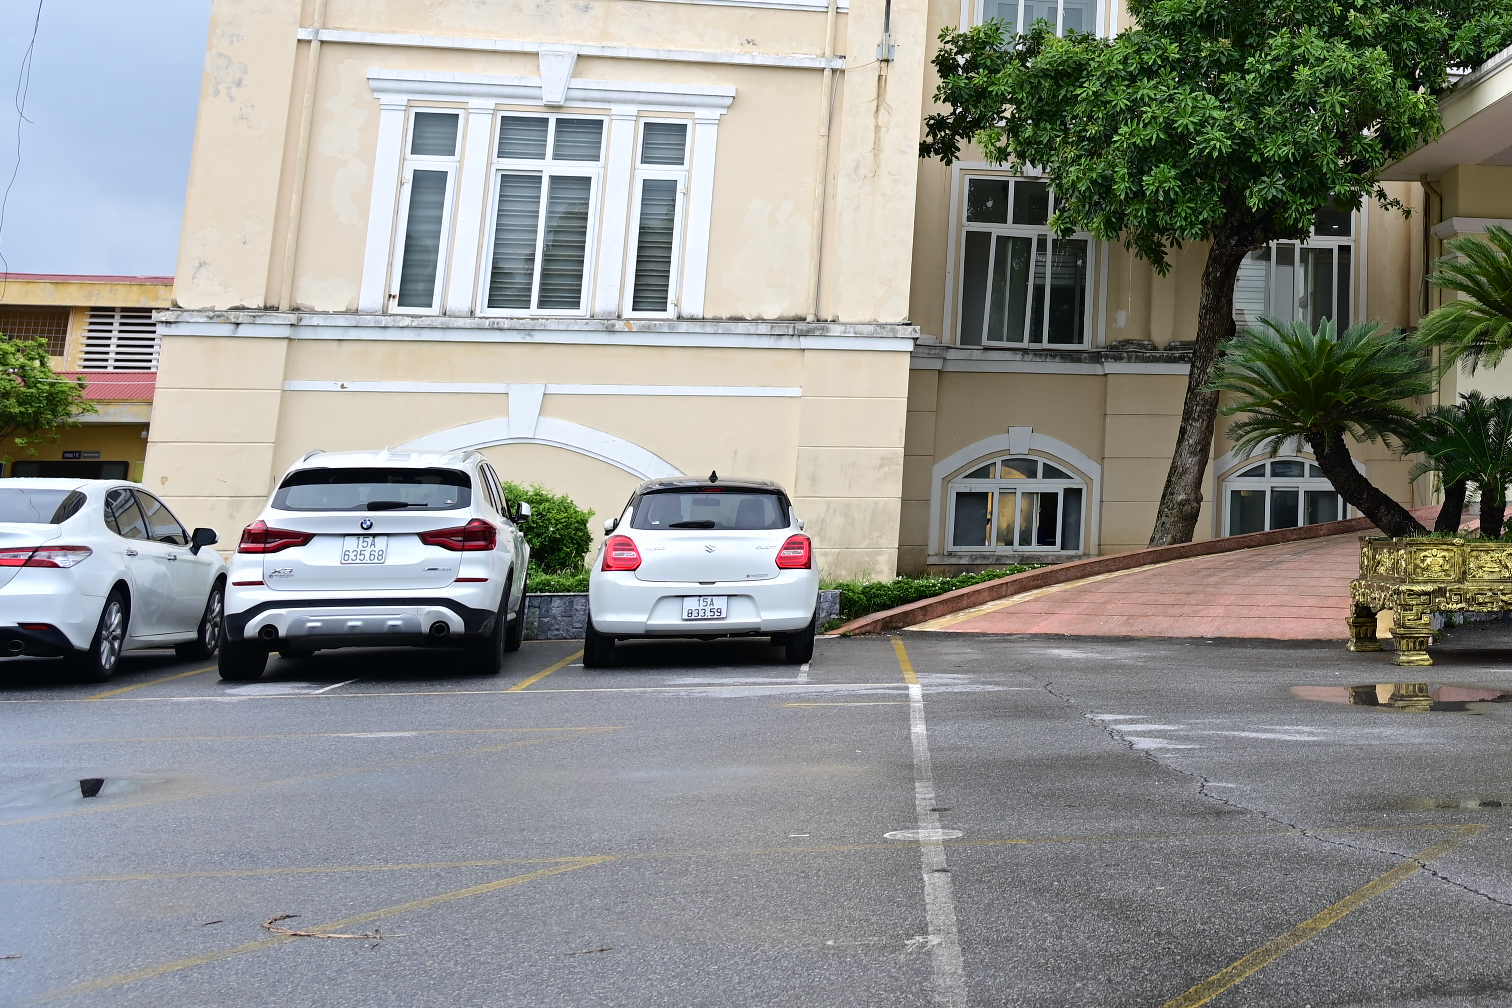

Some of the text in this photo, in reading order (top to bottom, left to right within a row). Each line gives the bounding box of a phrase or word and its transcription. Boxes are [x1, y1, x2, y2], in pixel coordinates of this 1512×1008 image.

[356, 536, 376, 549] 15A
[343, 549, 385, 562] 635.68
[697, 597, 715, 608] 15A
[686, 607, 723, 618] 833.59
